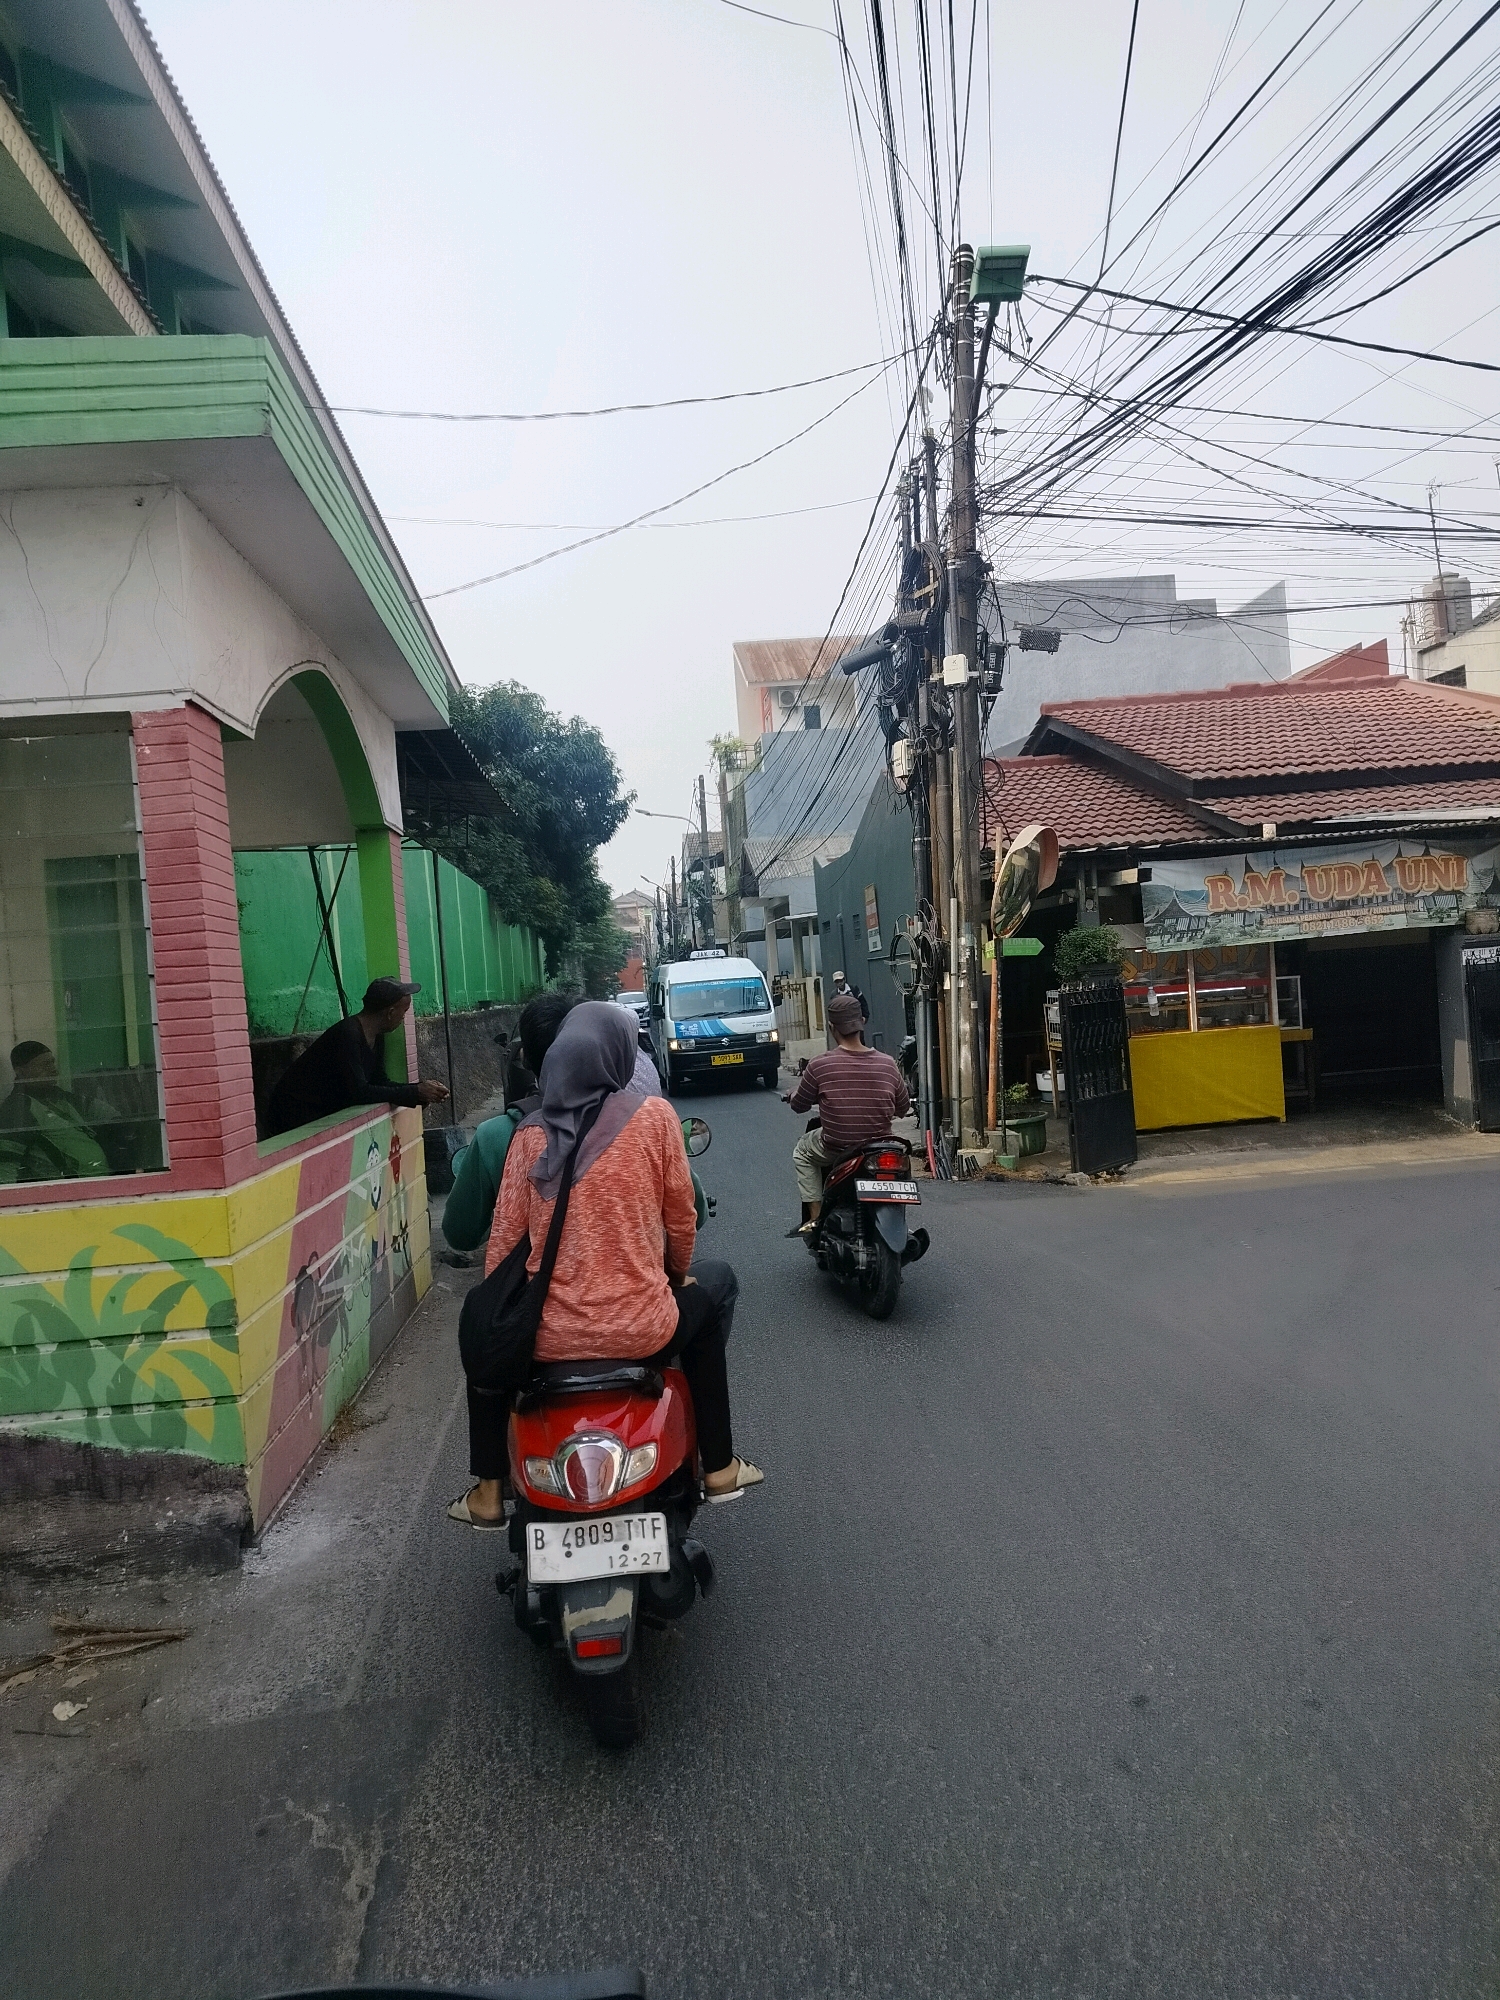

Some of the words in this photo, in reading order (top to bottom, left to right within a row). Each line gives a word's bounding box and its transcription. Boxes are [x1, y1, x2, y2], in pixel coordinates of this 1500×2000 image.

[1205, 870, 1300, 912] R.M.
[1301, 861, 1391, 902] UDA
[1392, 855, 1468, 893] UNI
[1348, 908, 1369, 918] KOTAK
[1373, 906, 1390, 916] NASI
[860, 1182, 866, 1190] B
[872, 1182, 894, 1191] 4550
[899, 1183, 916, 1192] TCH
[534, 1528, 545, 1550] B
[562, 1521, 614, 1549] 4809
[624, 1517, 662, 1541] TTF
